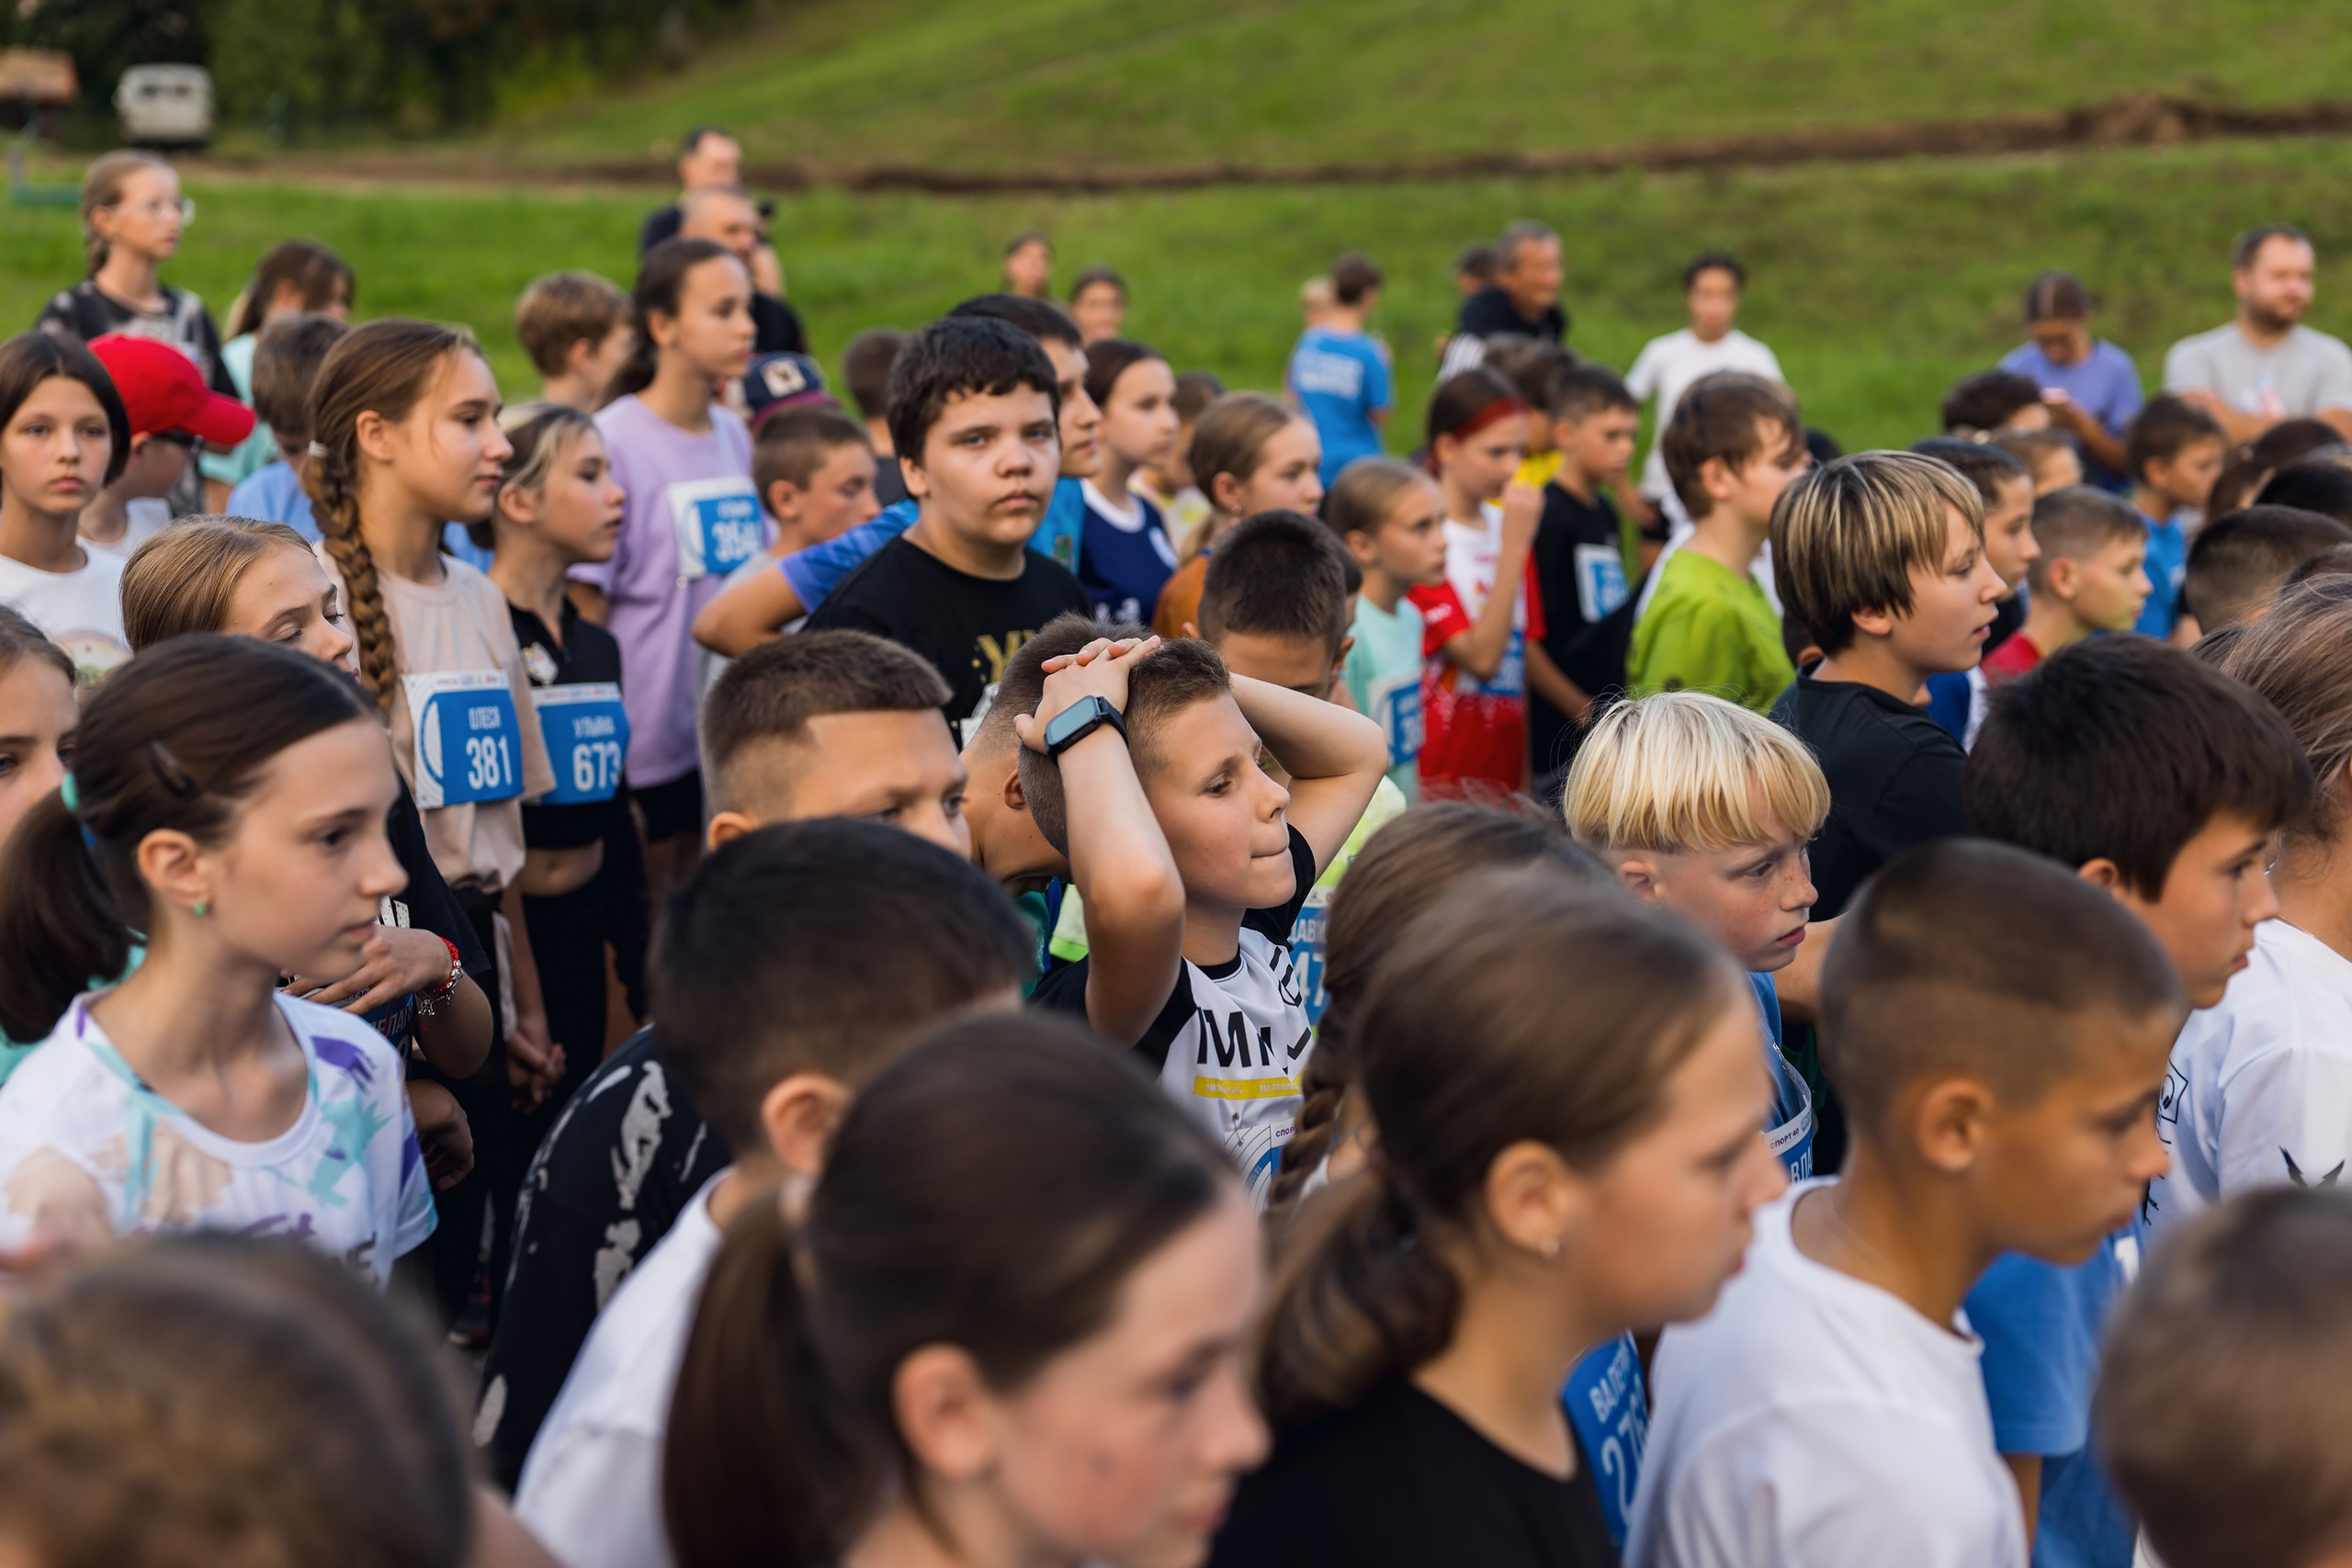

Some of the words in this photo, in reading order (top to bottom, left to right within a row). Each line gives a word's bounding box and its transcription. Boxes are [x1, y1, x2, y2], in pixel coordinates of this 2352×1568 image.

[469, 705, 502, 730] ОЛЕСЯ
[466, 735, 512, 790] 381
[572, 741, 622, 792] 673
[1275, 1126, 1295, 1138] СПОР
[1770, 1132, 1792, 1149] СПОРТ
